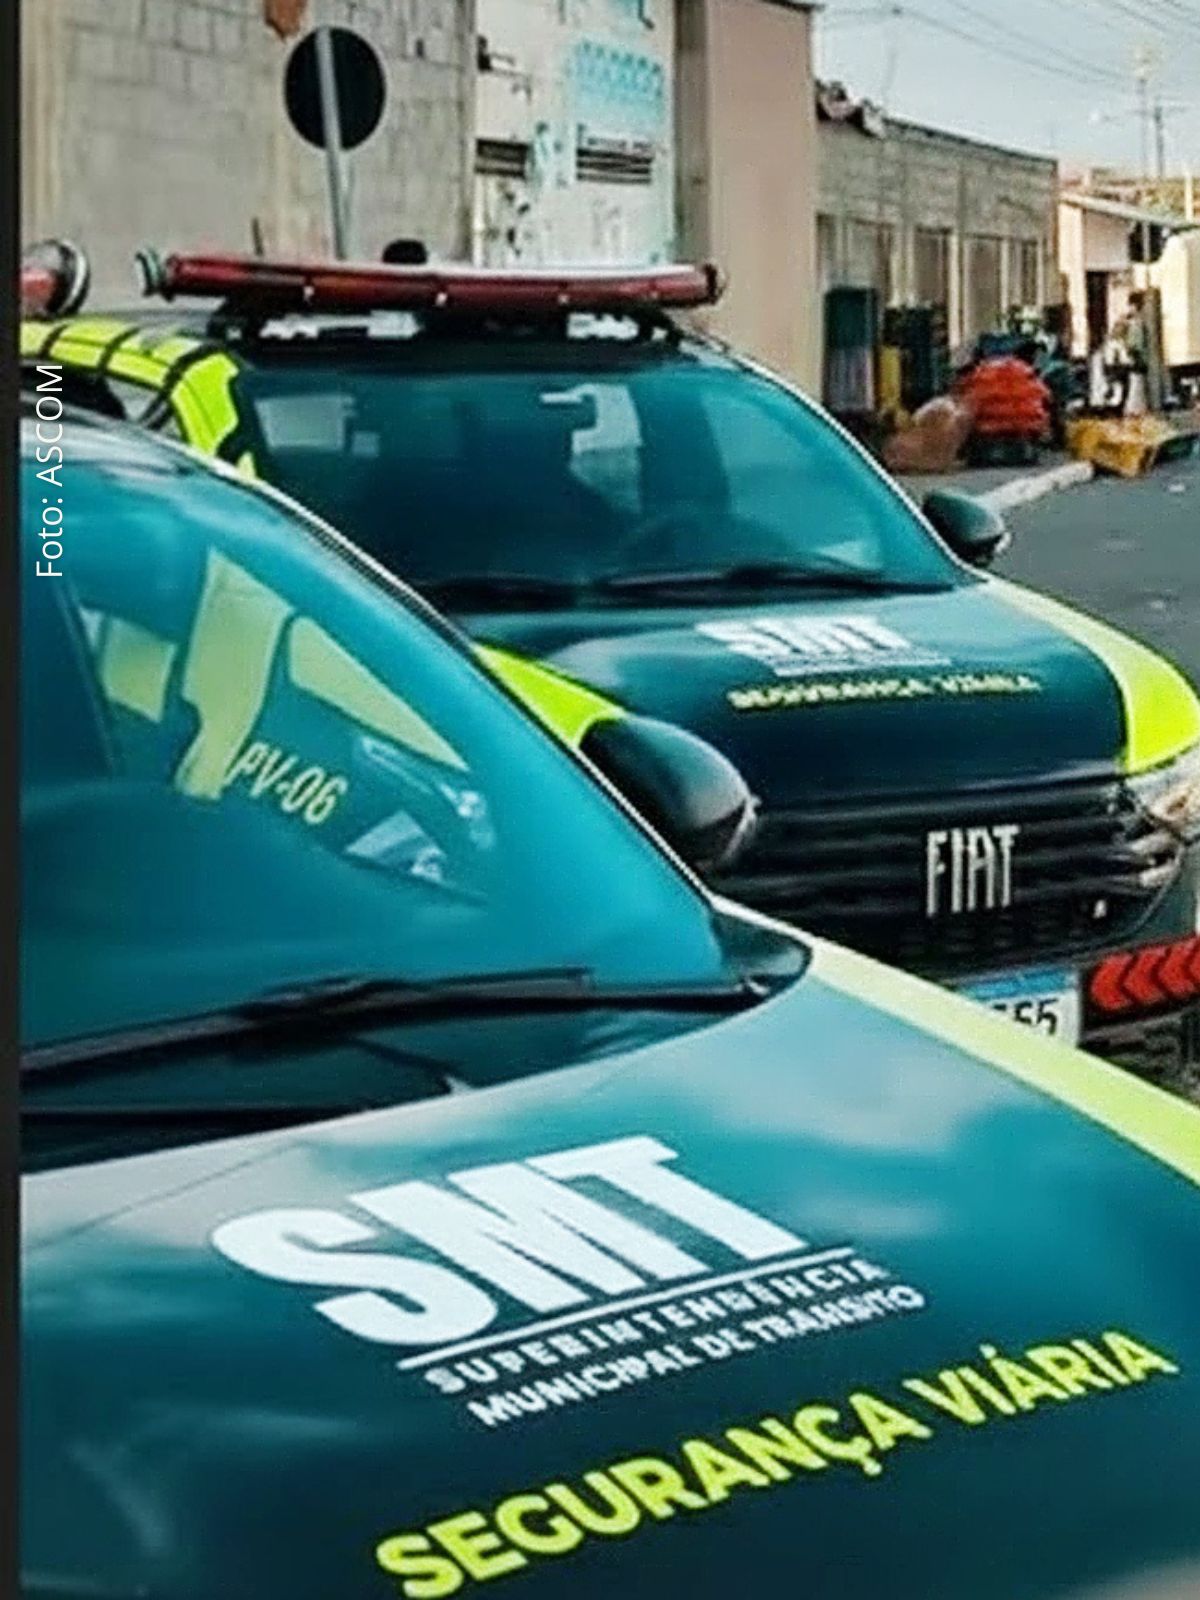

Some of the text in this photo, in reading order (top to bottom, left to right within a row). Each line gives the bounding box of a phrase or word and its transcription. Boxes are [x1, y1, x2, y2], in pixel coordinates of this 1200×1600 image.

[222, 742, 348, 824] PV-06
[926, 824, 1022, 918] FIAT
[211, 1135, 809, 1346] SMT
[467, 1347, 704, 1428] MUNICIPAL
[691, 1328, 757, 1360] DE
[376, 1330, 1180, 1599] SEGURANÇA VIÁRIA
